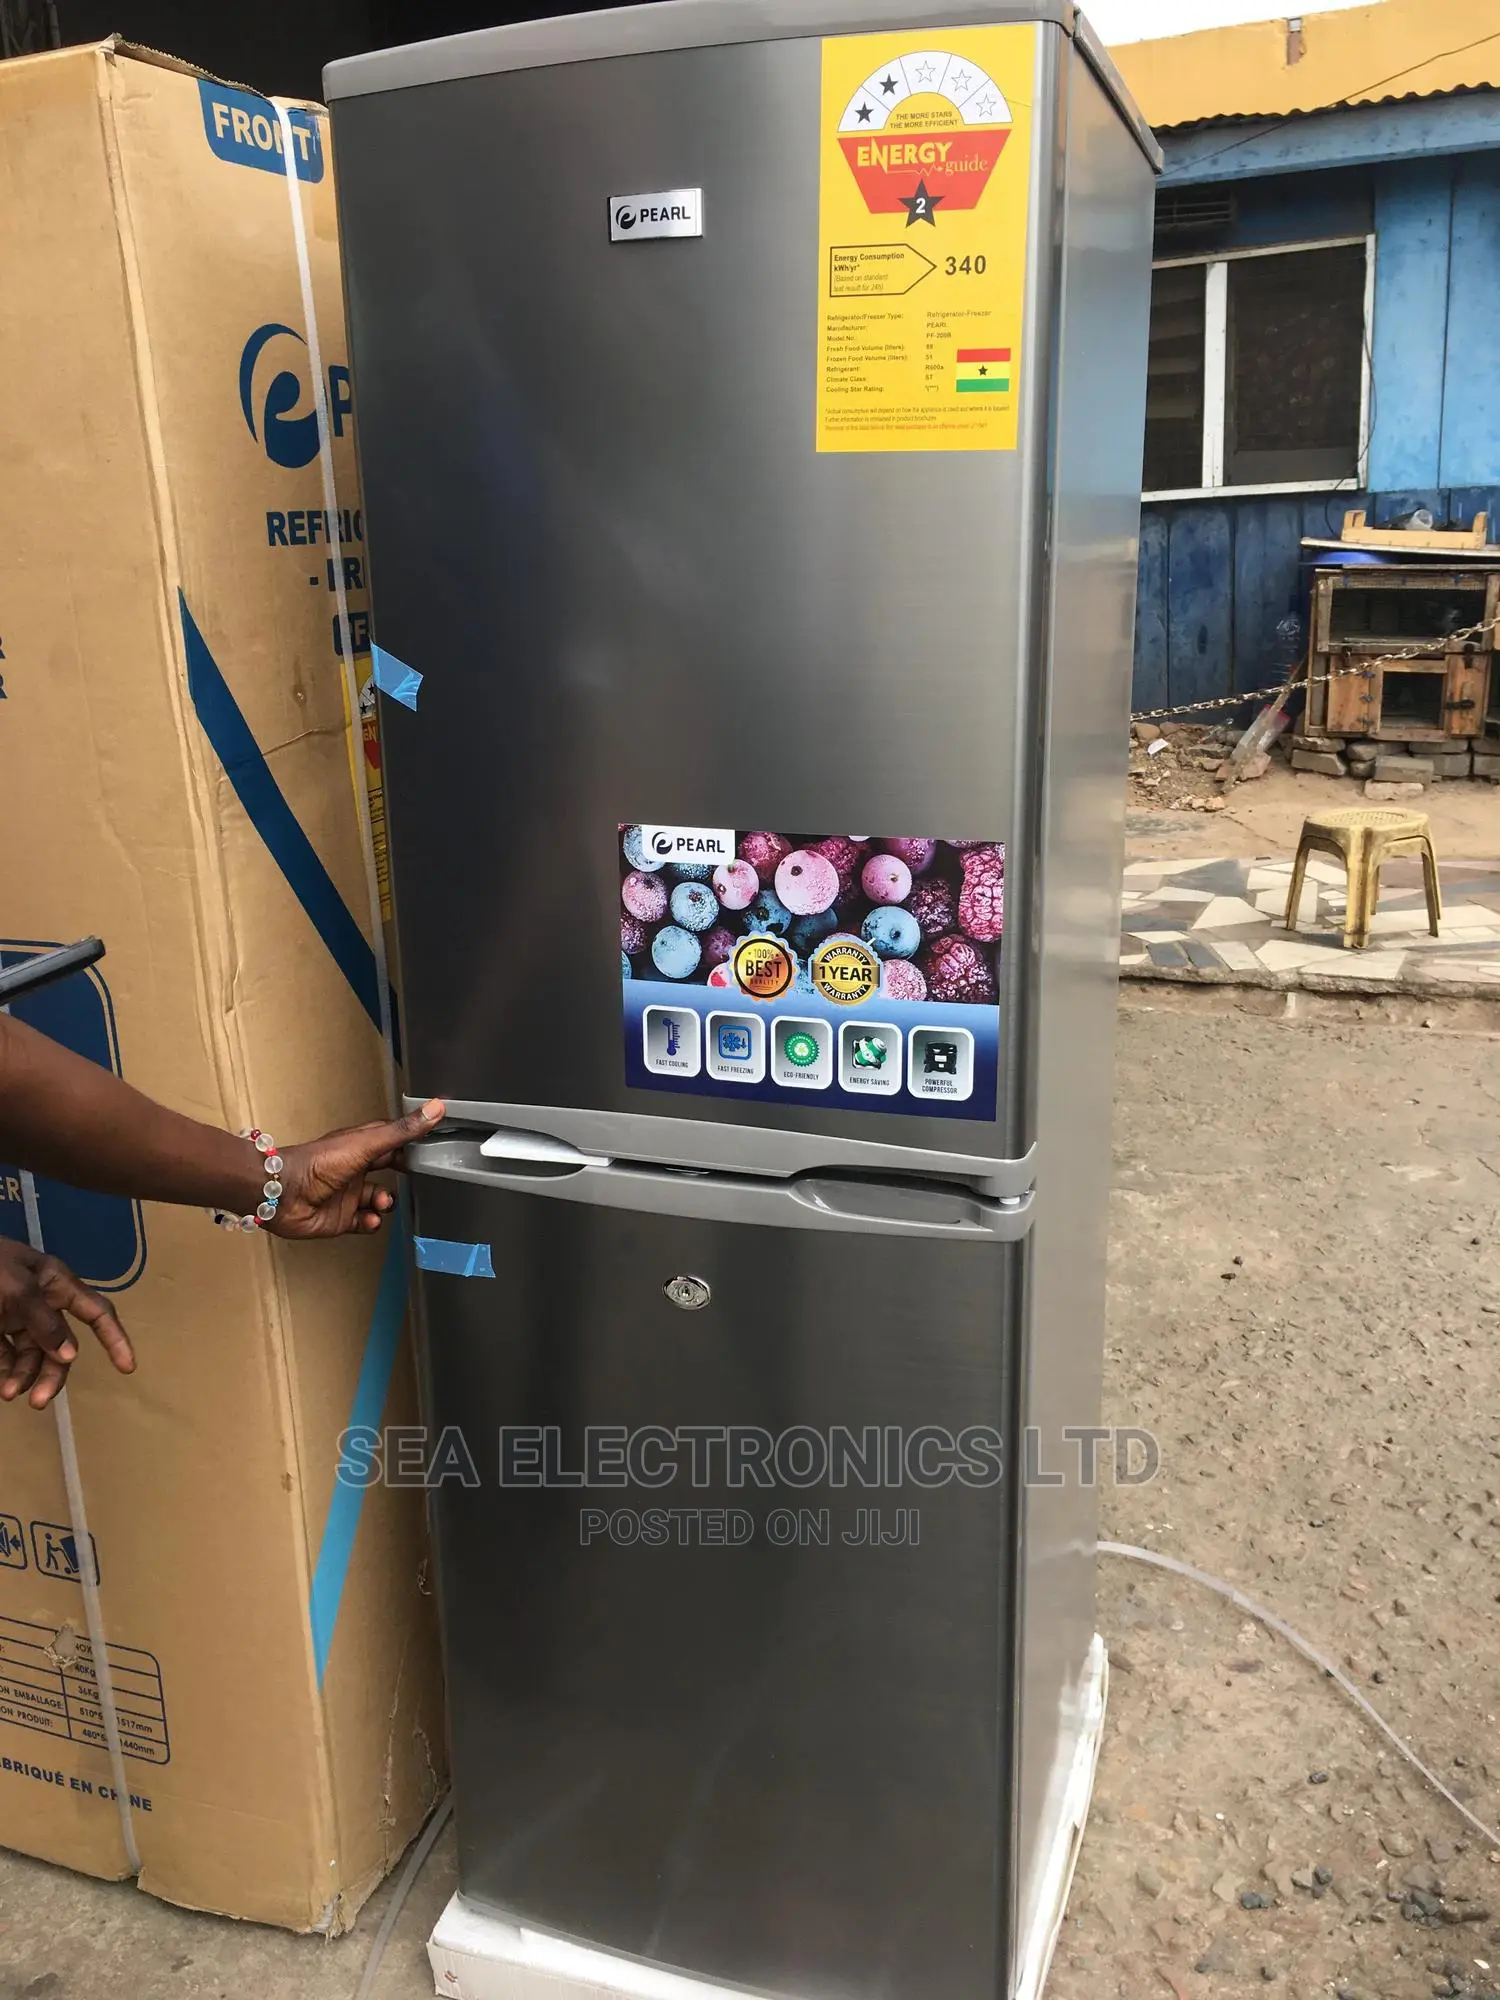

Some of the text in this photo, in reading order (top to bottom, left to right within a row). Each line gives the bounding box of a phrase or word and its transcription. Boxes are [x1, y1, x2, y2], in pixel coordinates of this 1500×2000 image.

[926, 120, 958, 128] EFFICIENT
[857, 136, 952, 174] ENERGY
[945, 154, 988, 176] guide
[640, 206, 691, 222] PEARL
[916, 198, 926, 214] 2
[834, 252, 905, 263] Energy Consumption
[945, 255, 987, 276] 340
[676, 837, 725, 854] PEARL
[754, 948, 775, 959] 100%
[824, 947, 867, 964] WARRANTY
[745, 960, 782, 978] BEST
[819, 966, 872, 982] 1 YEAR
[824, 983, 867, 1001] WARRANTY
[655, 1058, 688, 1068] FAST COOLING
[718, 1065, 754, 1075] FAST FREEZING
[783, 1071, 819, 1080] ECO-FRIENDLY
[849, 1077, 890, 1086] ENERGY SAVING
[924, 1078, 953, 1086] POWERFUL
[921, 1086, 958, 1094] COMPRESSOR
[14, 1690, 65, 1710] EMBALLAGE:
[17, 1711, 53, 1728] PRODUIT:
[0, 1757, 65, 1787] BRIQUÉ
[70, 1777, 93, 1794] EN
